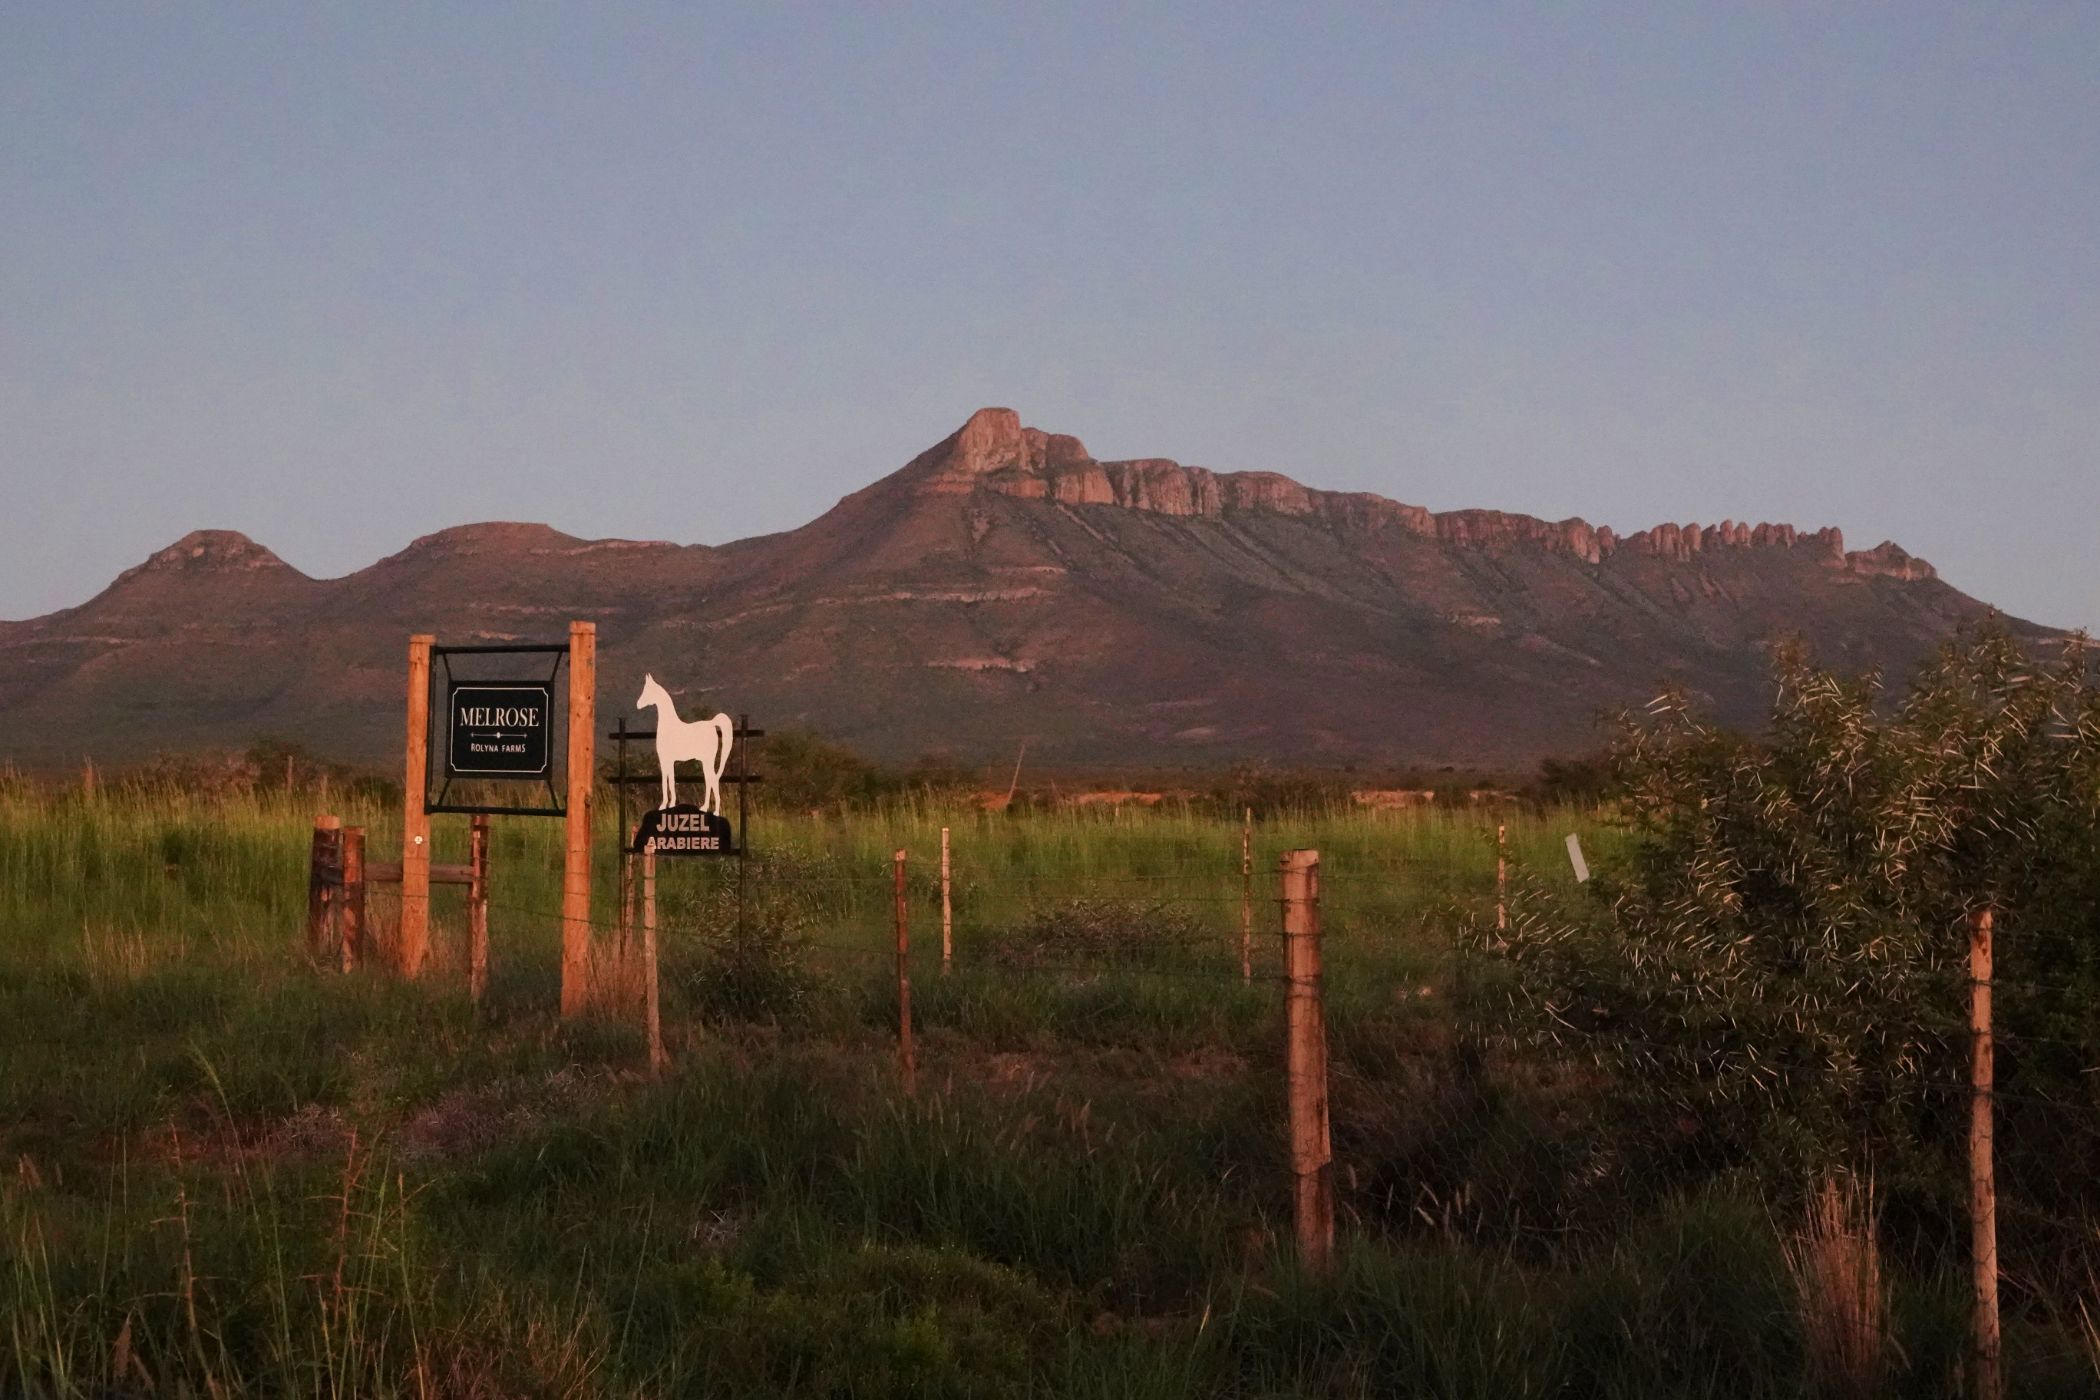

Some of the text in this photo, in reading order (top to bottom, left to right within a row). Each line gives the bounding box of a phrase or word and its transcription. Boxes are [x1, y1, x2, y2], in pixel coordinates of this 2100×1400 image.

[460, 707, 539, 727] MELROSE
[471, 743, 526, 753] ROLYNA FARMS
[656, 813, 710, 832] JUZEL
[646, 836, 719, 850] ARABIERE
